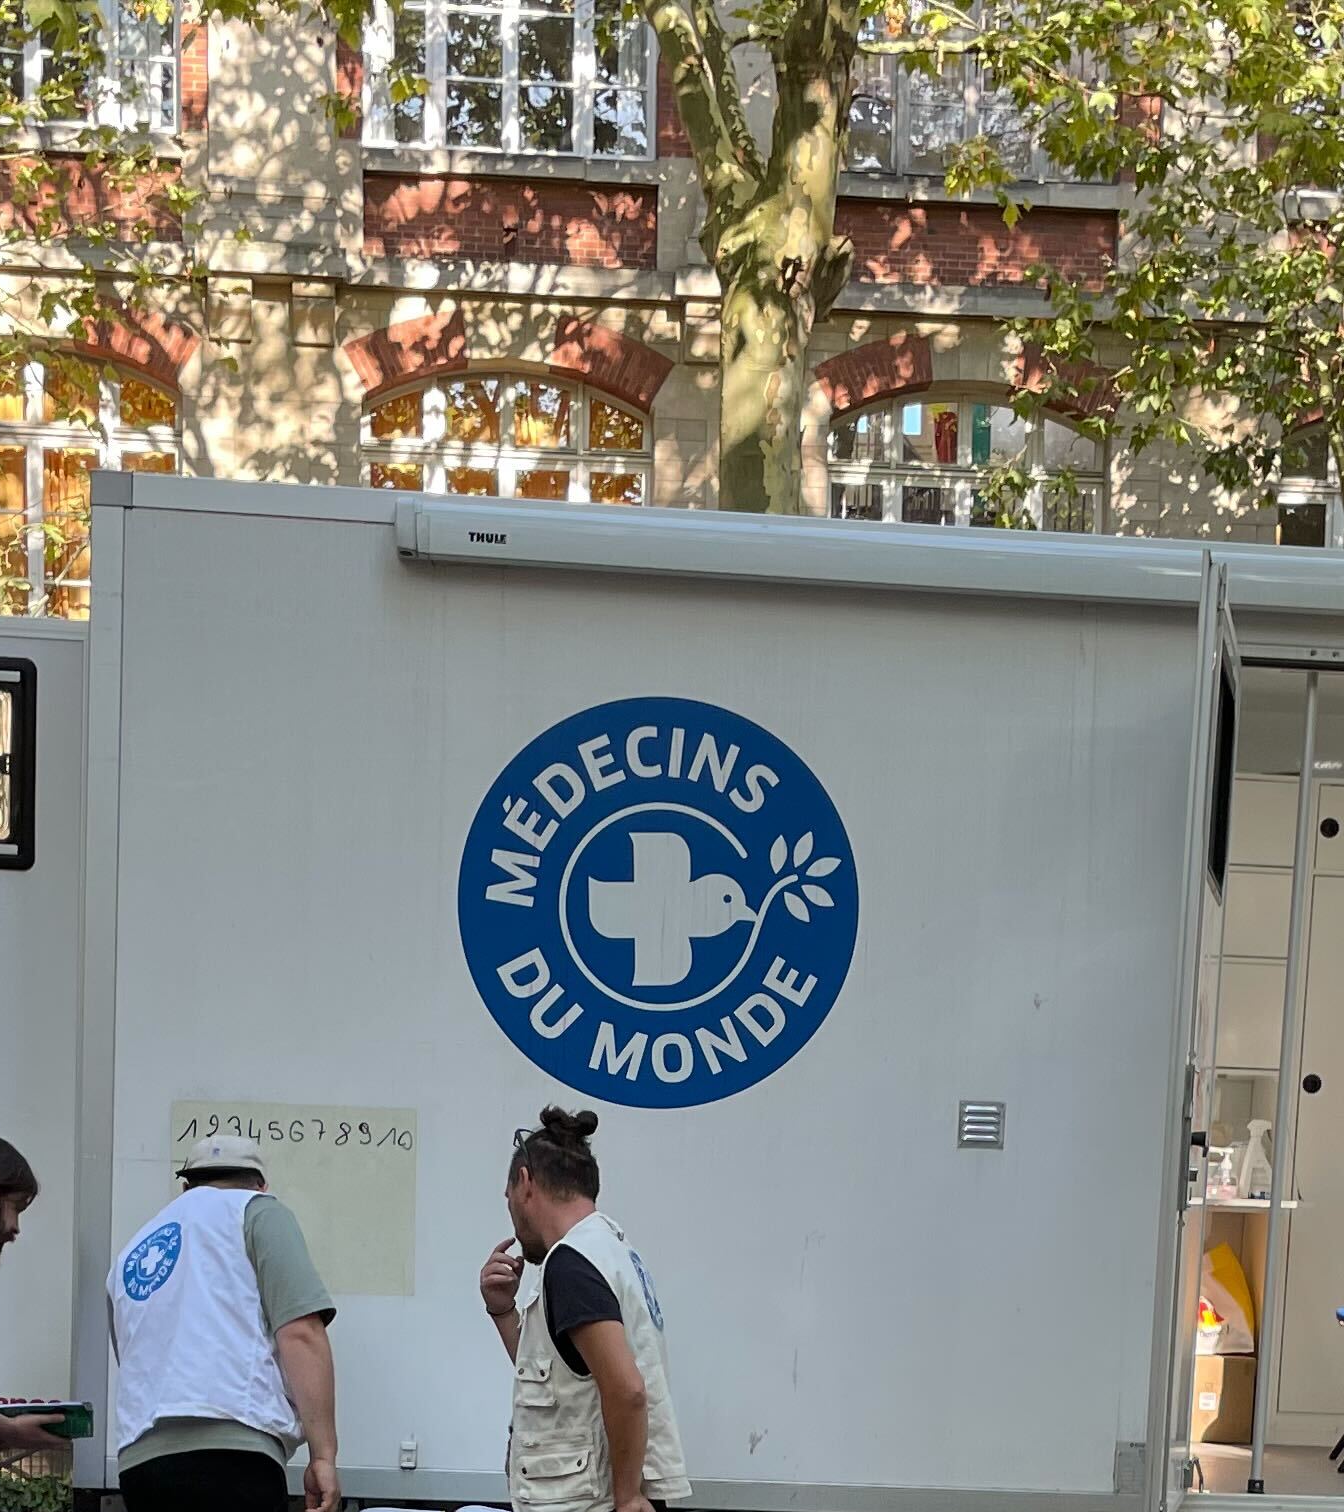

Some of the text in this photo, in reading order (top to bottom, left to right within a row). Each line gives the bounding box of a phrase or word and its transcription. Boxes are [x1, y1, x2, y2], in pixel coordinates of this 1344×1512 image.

[469, 532, 507, 544] THULE
[485, 725, 780, 908] MÉDECINS
[496, 947, 818, 1084] DU MONDE
[268, 1121, 284, 1141] 5
[312, 1119, 326, 1140] 7
[335, 1122, 352, 1146] 8
[377, 1128, 413, 1150] 10
